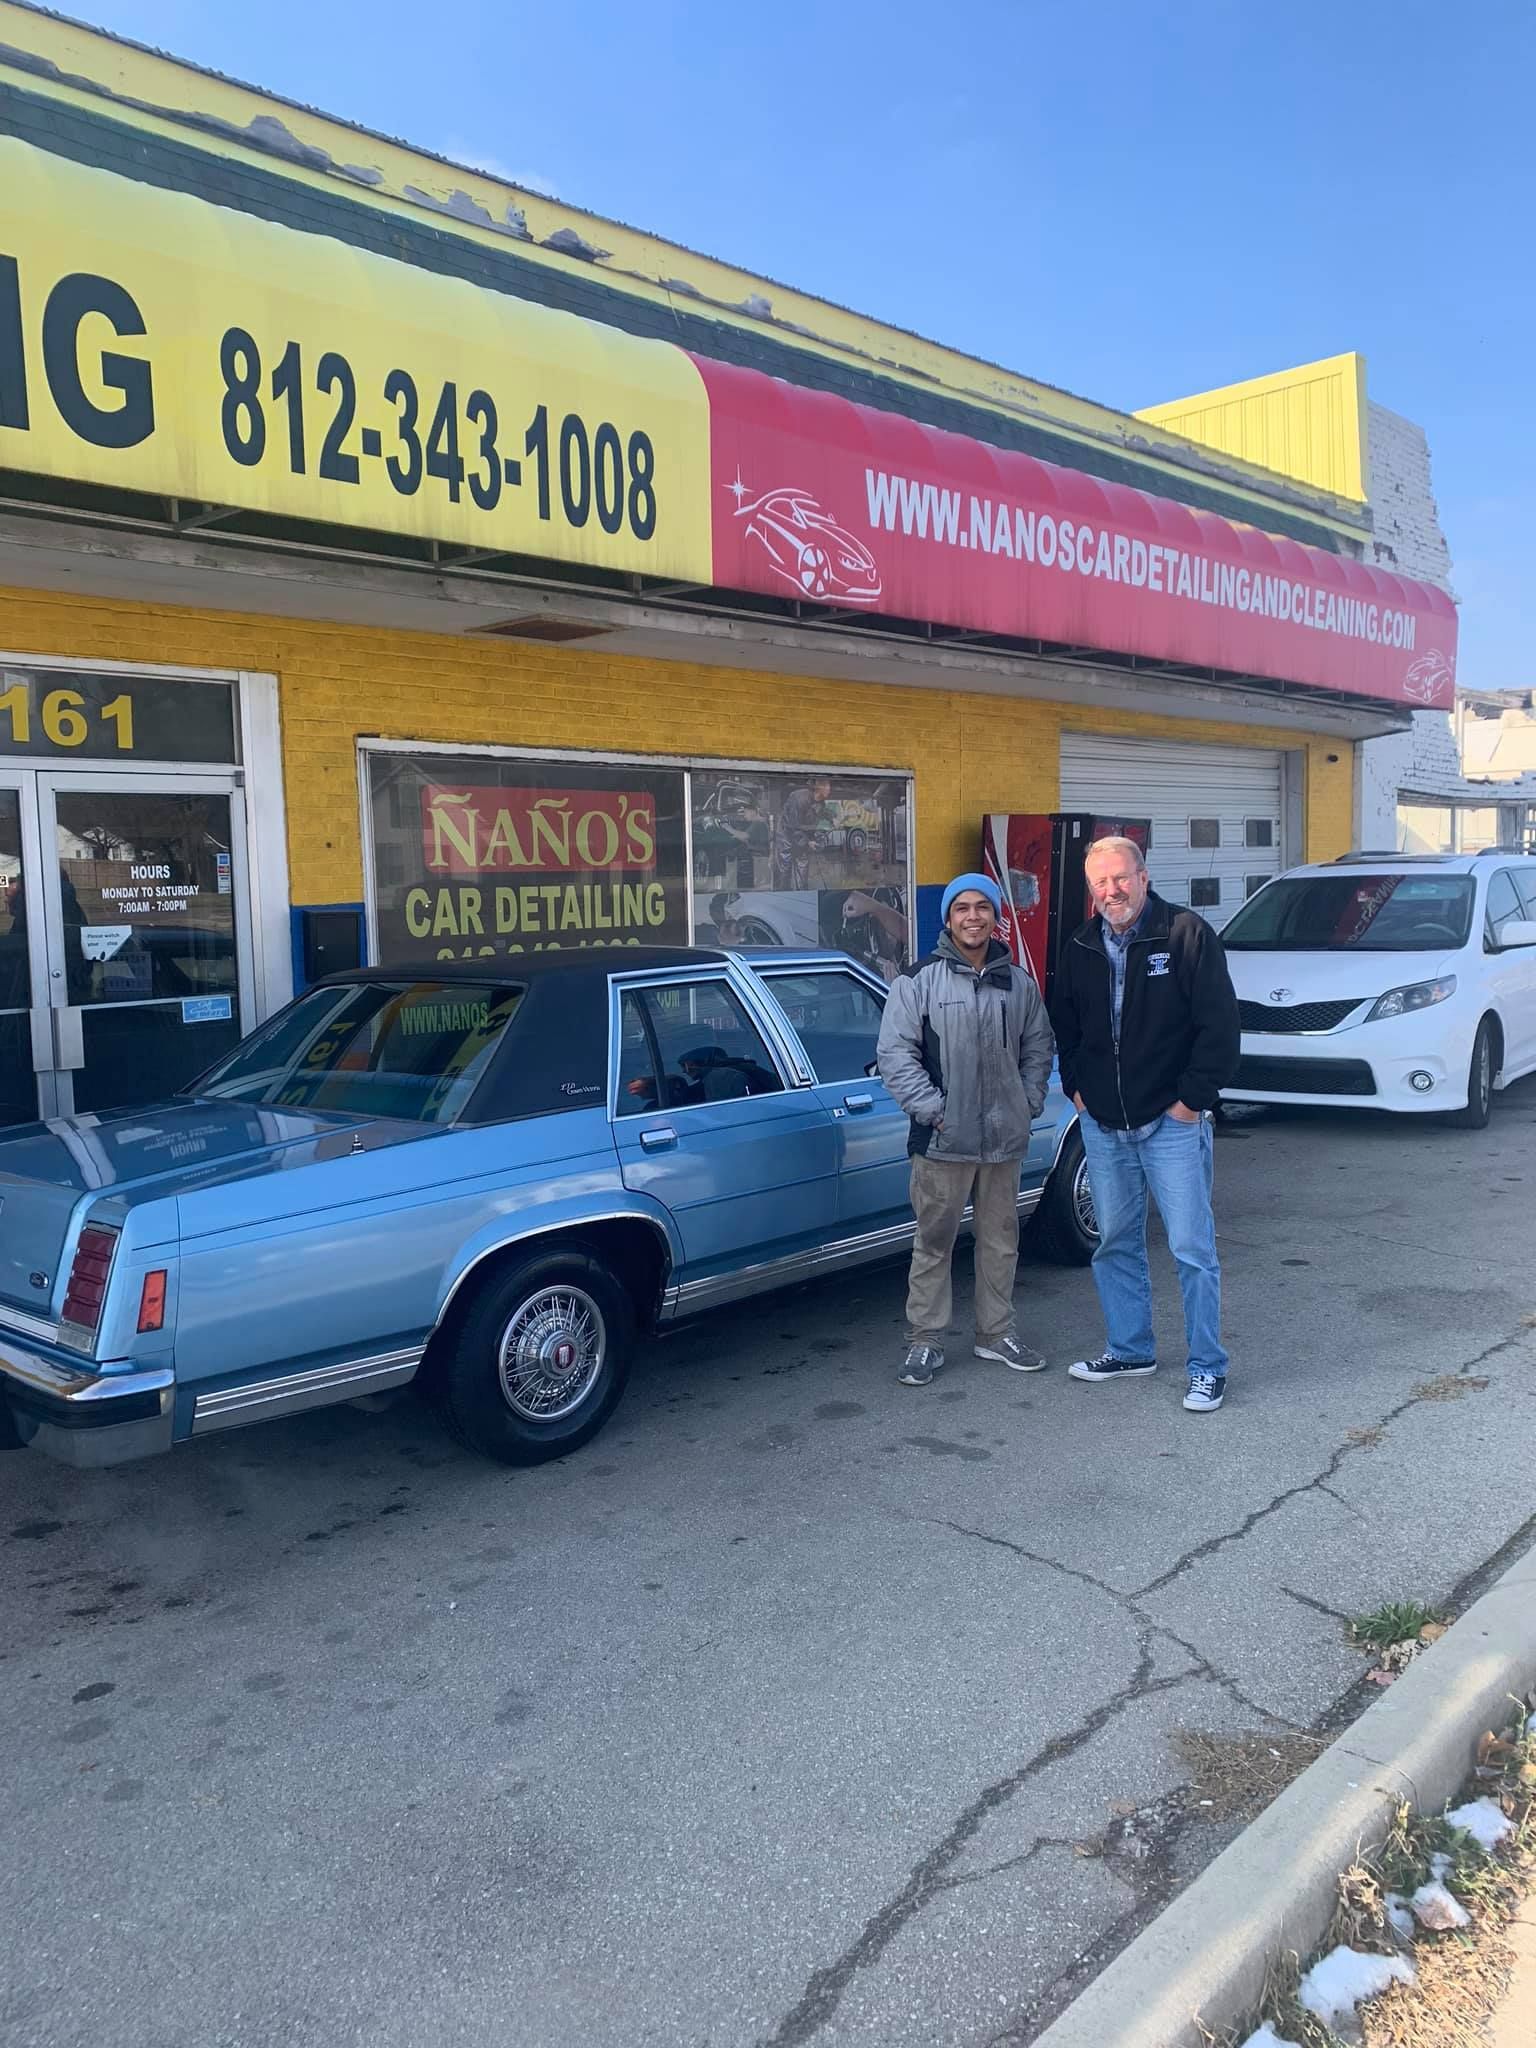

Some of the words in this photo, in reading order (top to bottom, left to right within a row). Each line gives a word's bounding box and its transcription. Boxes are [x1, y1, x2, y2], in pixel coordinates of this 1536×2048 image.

[0, 254, 155, 449] G
[220, 327, 656, 540] 812-343-1008
[865, 468, 1417, 651] WWW.NANOSCARDETAILINGANDCLEANING.COM
[0, 684, 134, 749] 161
[427, 793, 654, 868] ÑAÑO'S
[102, 887, 139, 899] MONDAY
[141, 886, 153, 897] TO
[155, 885, 199, 897] SATURDAY
[131, 865, 171, 879] HOURS
[118, 901, 150, 913] 7:00AM
[156, 899, 187, 911] 7:00PM
[406, 888, 484, 937] CAR
[495, 883, 666, 933] DETAILING
